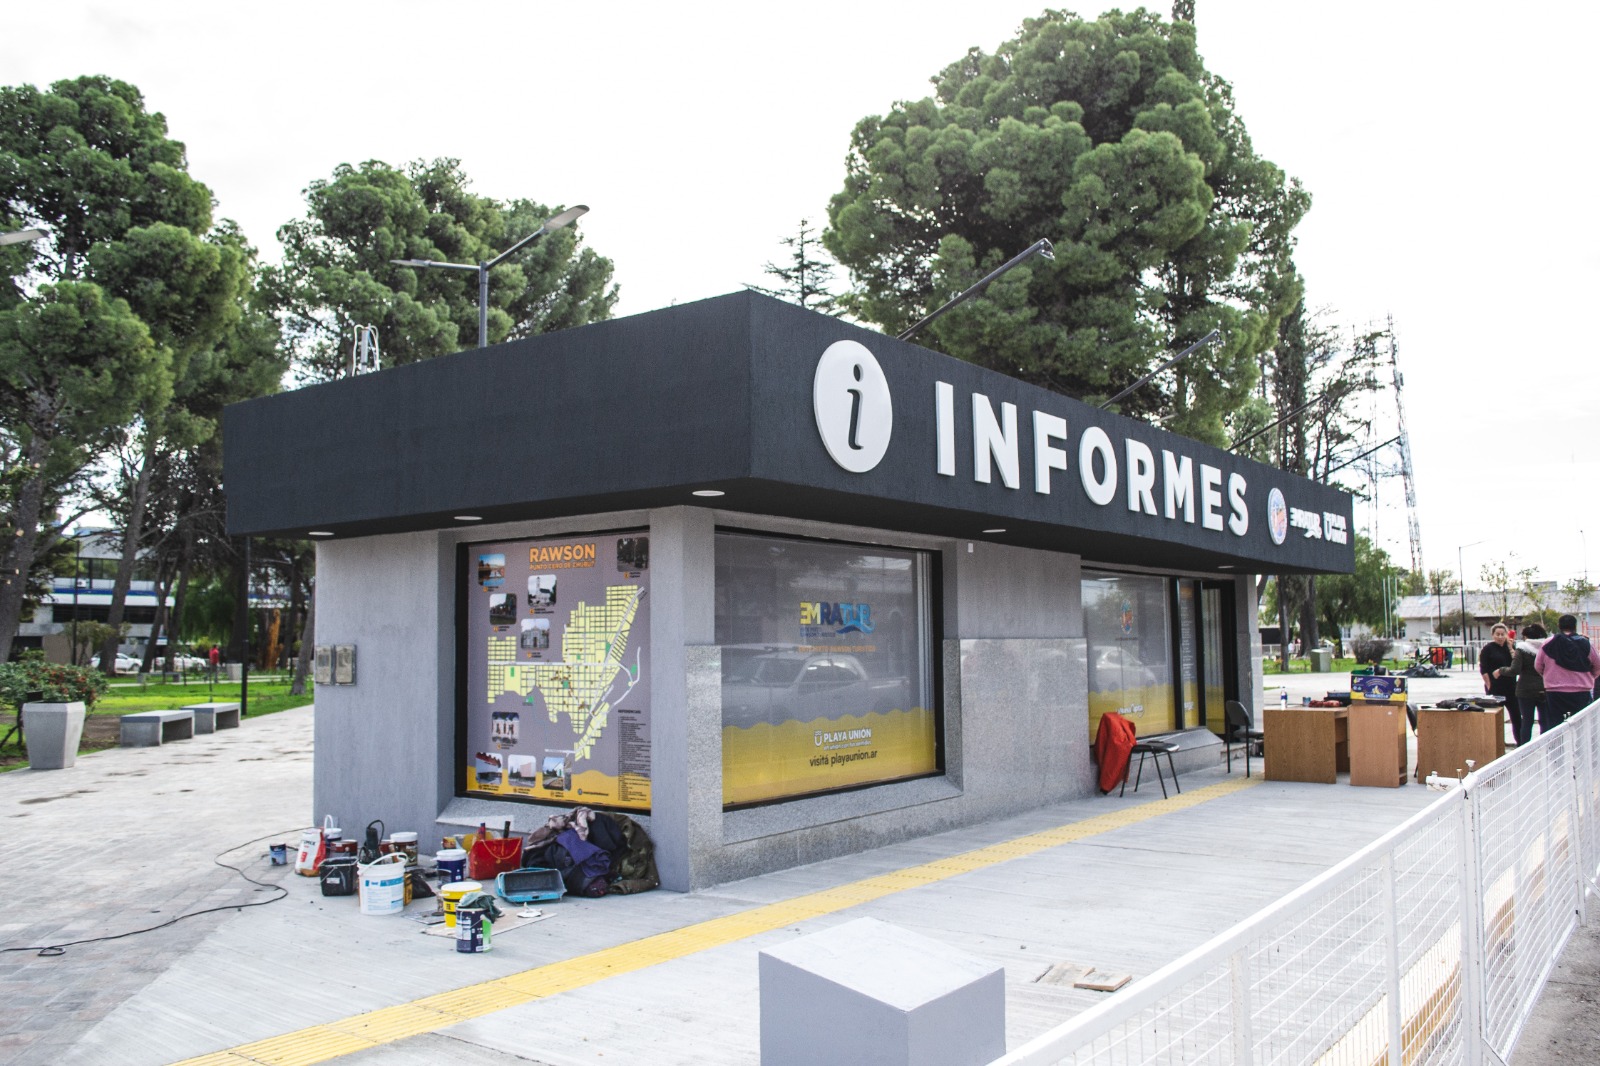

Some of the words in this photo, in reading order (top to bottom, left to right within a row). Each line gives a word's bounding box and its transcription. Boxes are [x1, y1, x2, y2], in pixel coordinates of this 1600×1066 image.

[935, 380, 1249, 536] INFORMES
[529, 544, 596, 562] RAWSON
[800, 601, 872, 627] EMRATUR
[824, 731, 847, 742] PLAYA
[831, 749, 878, 767] playaunion.ar
